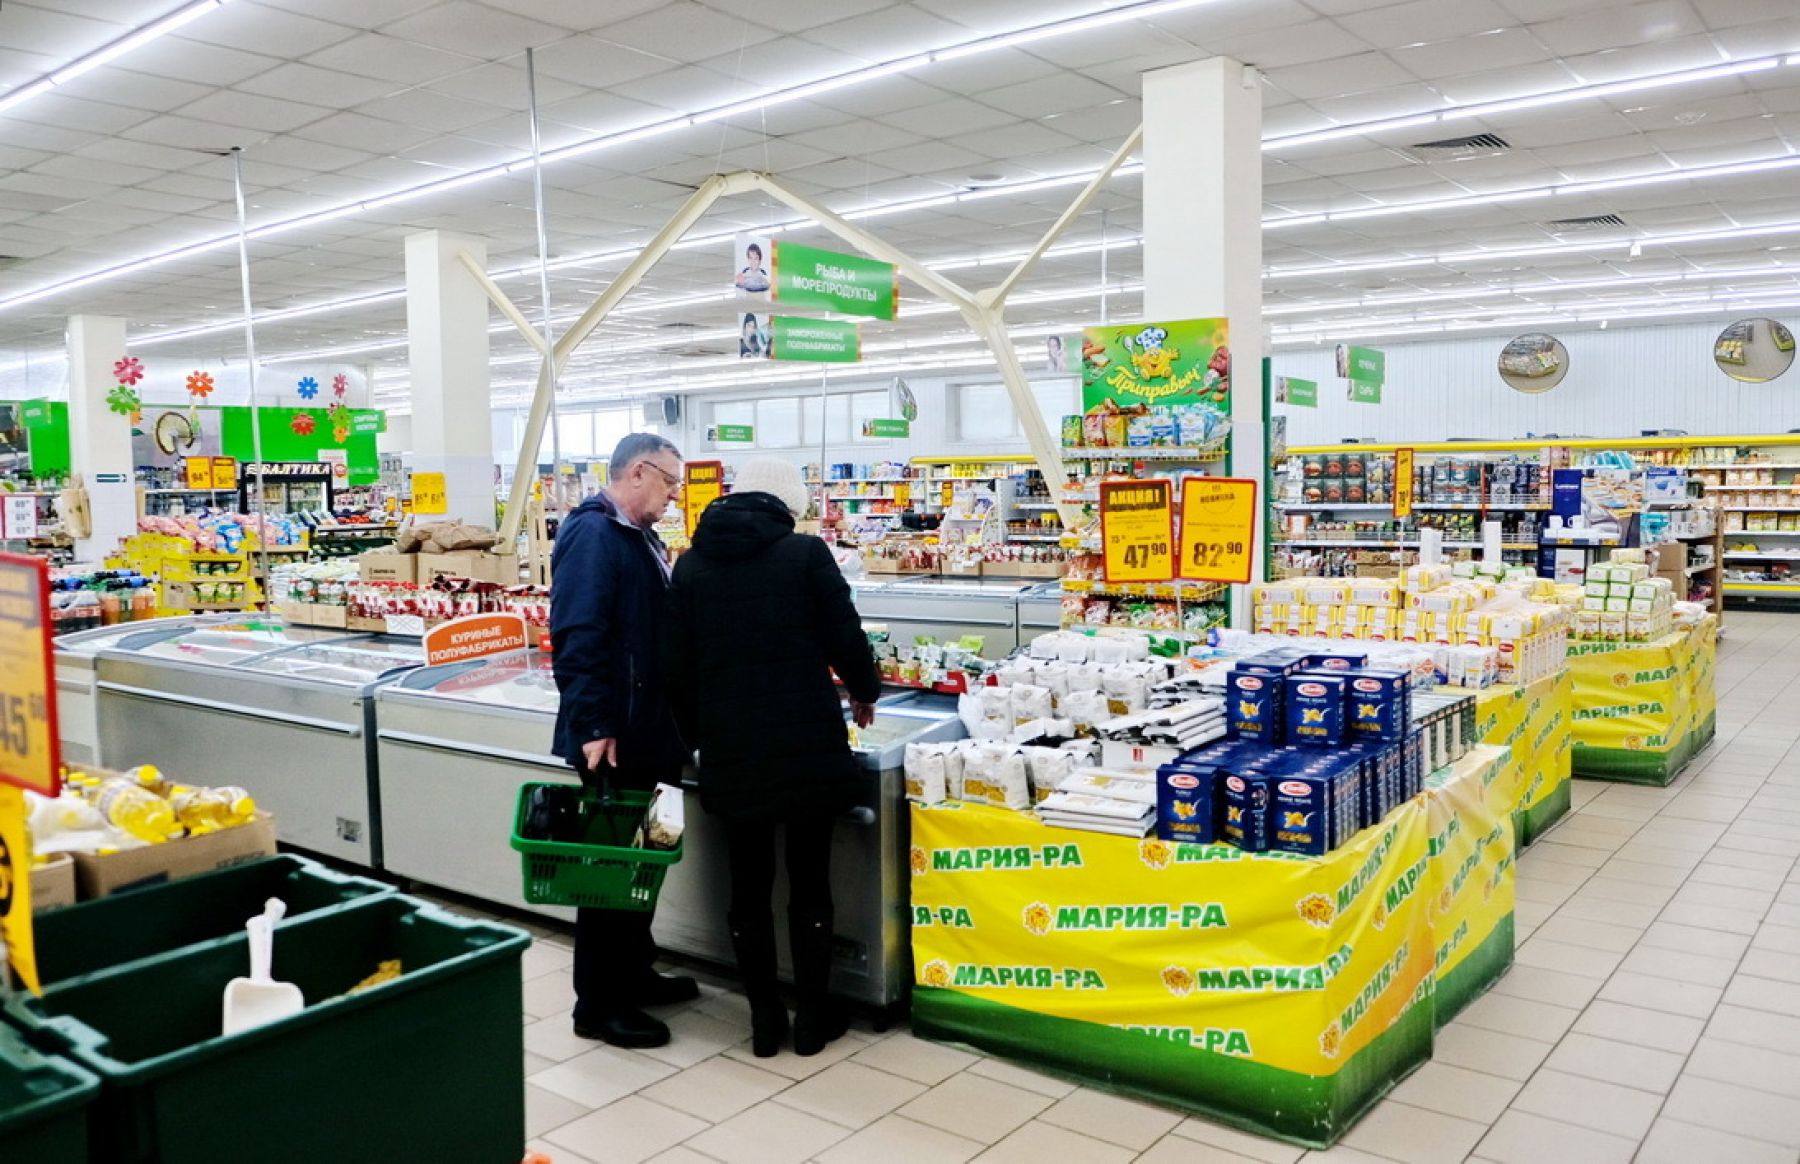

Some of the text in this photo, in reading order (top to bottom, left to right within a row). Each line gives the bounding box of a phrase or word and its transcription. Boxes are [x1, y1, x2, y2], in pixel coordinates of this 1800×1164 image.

[815, 263, 855, 281] РЫБА И
[792, 276, 877, 302] МОРЕПРОДУКТЫ
[1109, 489, 1160, 504] АКЦИЯ!
[450, 625, 502, 644] КУРИНЫЕ
[430, 635, 523, 662] ПОЛУФАБРИКАТЫ
[932, 845, 1083, 870] МАРИЯ-РА
[912, 906, 973, 928] Я-РА
[1055, 904, 1228, 930] МАРИЯ-РА
[953, 965, 1105, 989] МАРИЯ-РА
